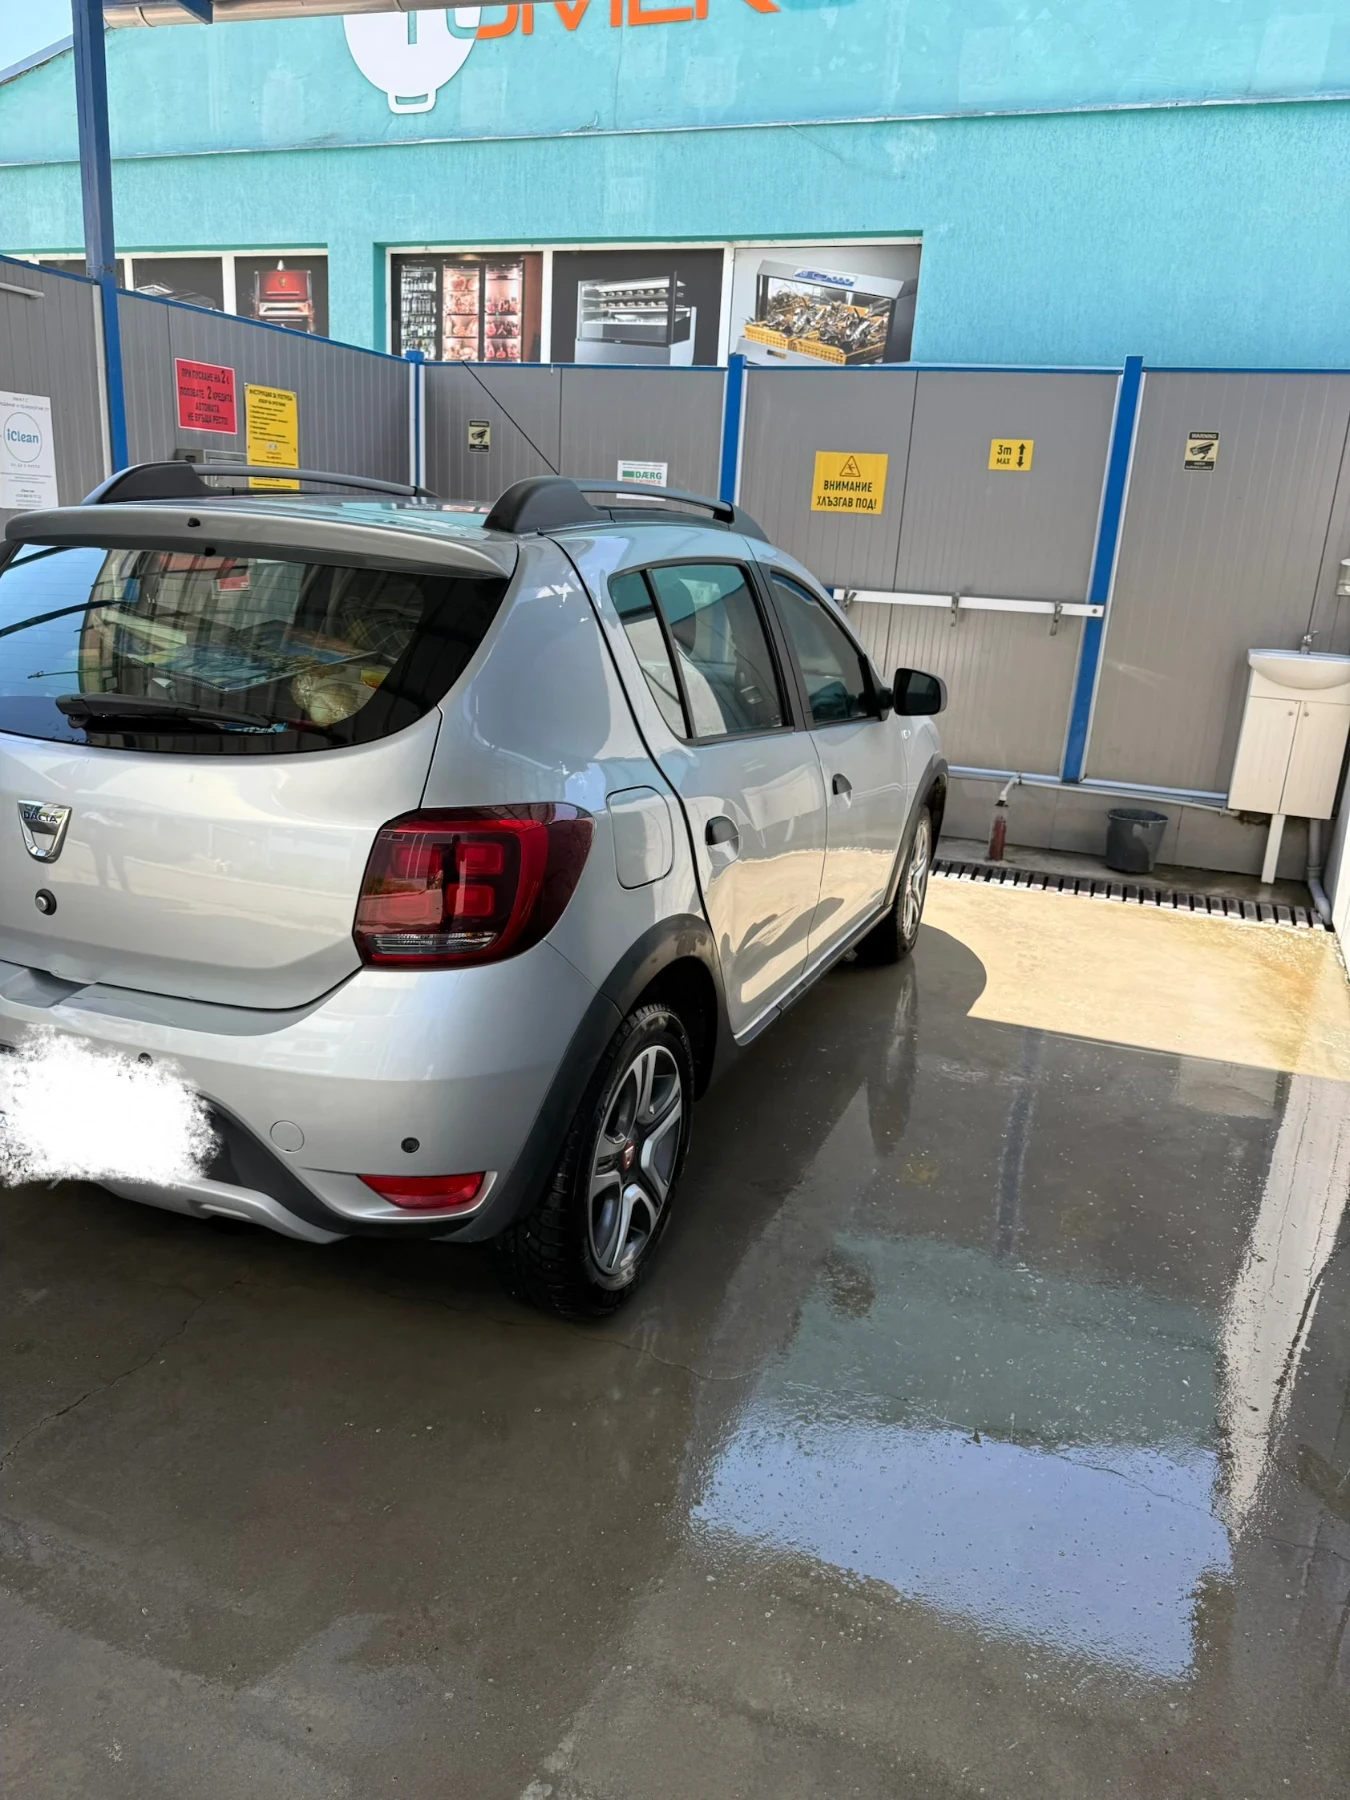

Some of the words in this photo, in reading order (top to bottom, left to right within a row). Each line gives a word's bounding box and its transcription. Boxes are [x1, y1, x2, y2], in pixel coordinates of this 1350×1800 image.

[221, 370, 226, 384] 2
[207, 386, 212, 400] 2
[7, 428, 39, 444] iClean
[997, 445, 1012, 456] 3m
[823, 480, 873, 492] ВНИМАНИЕ
[816, 495, 853, 508] ХЛЪЗГАВ
[855, 498, 877, 510] ПОД!
[23, 811, 58, 823] DACIA
